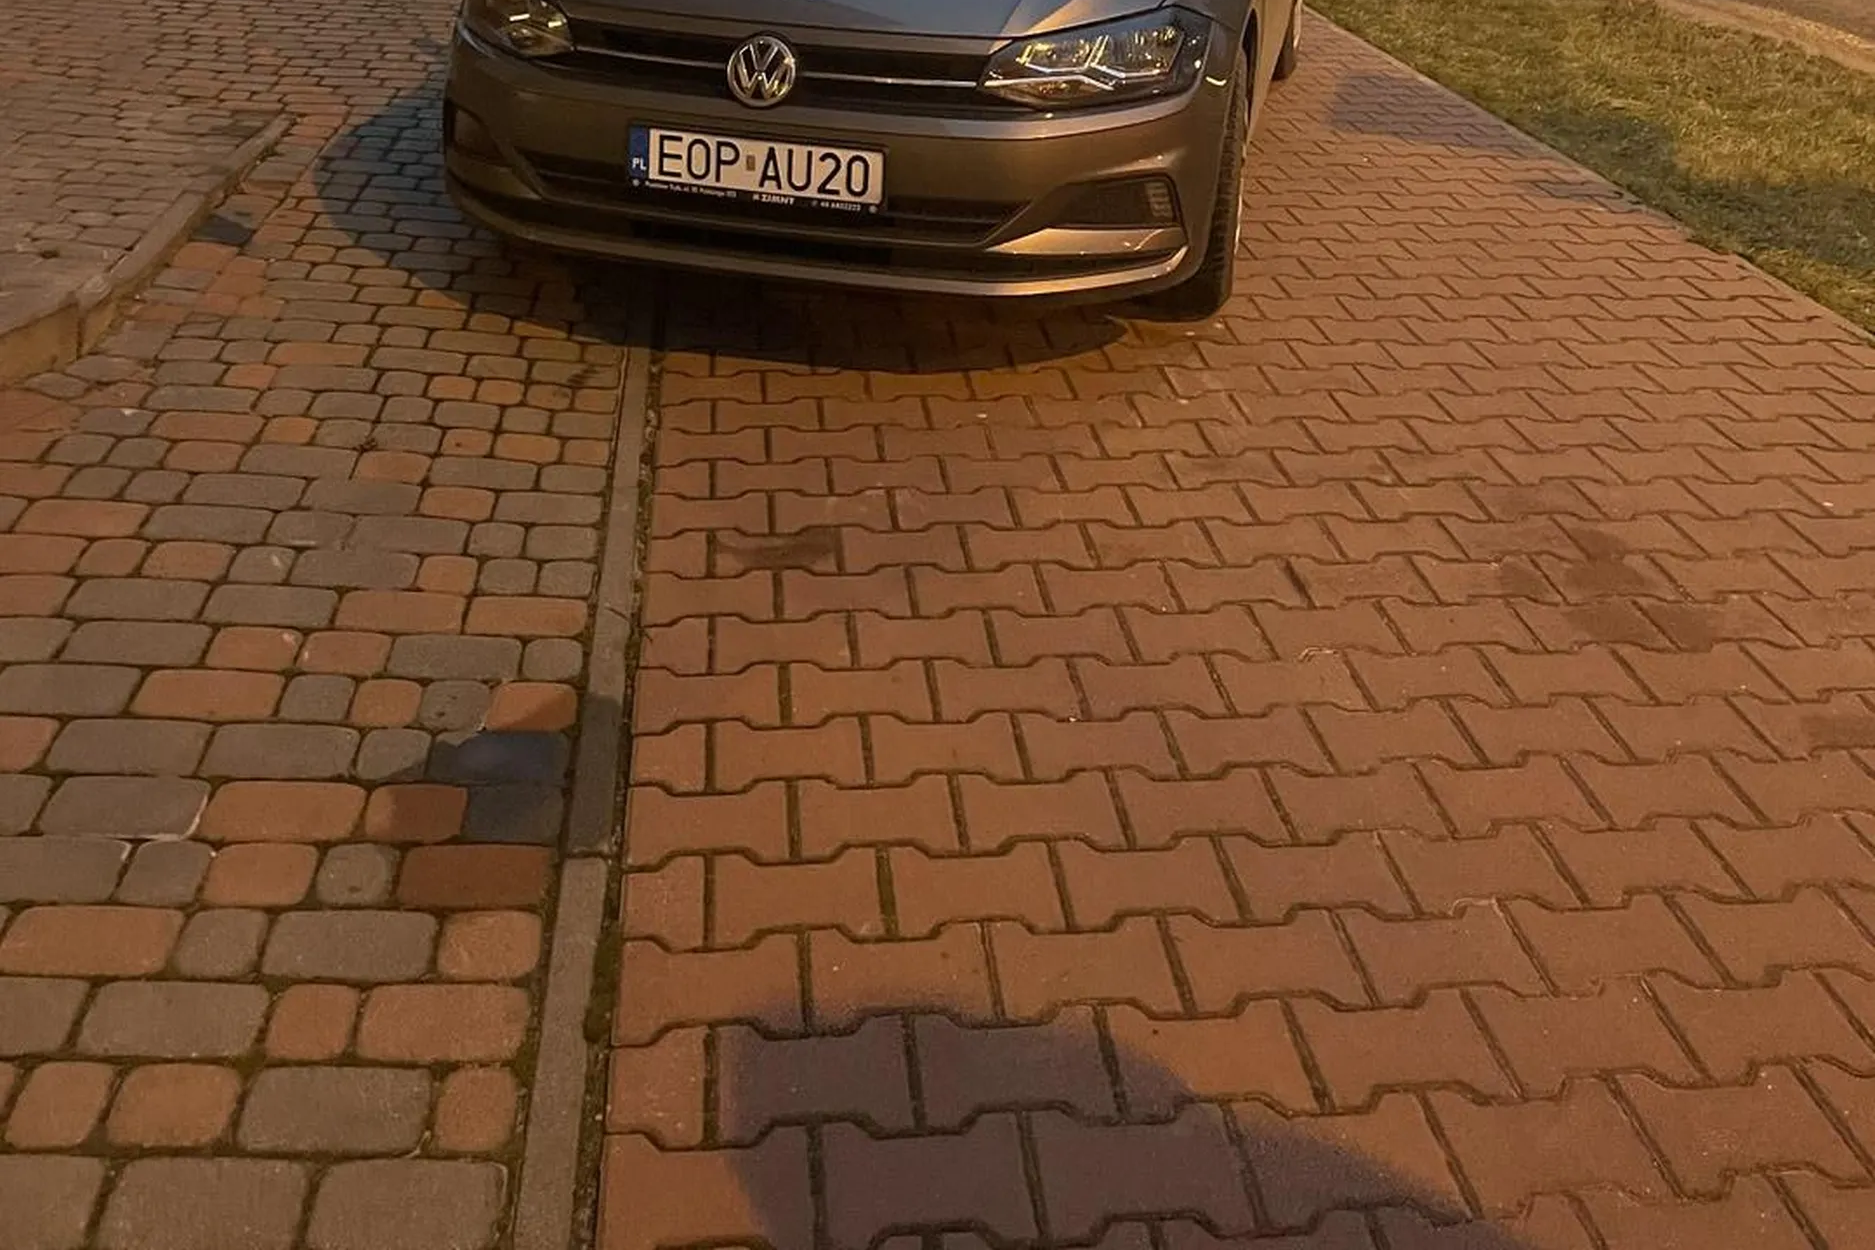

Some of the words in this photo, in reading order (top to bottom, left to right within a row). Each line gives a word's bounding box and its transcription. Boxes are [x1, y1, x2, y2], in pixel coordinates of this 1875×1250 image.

[632, 157, 647, 170] PL
[659, 134, 741, 183] EOP
[758, 146, 870, 197] AU20
